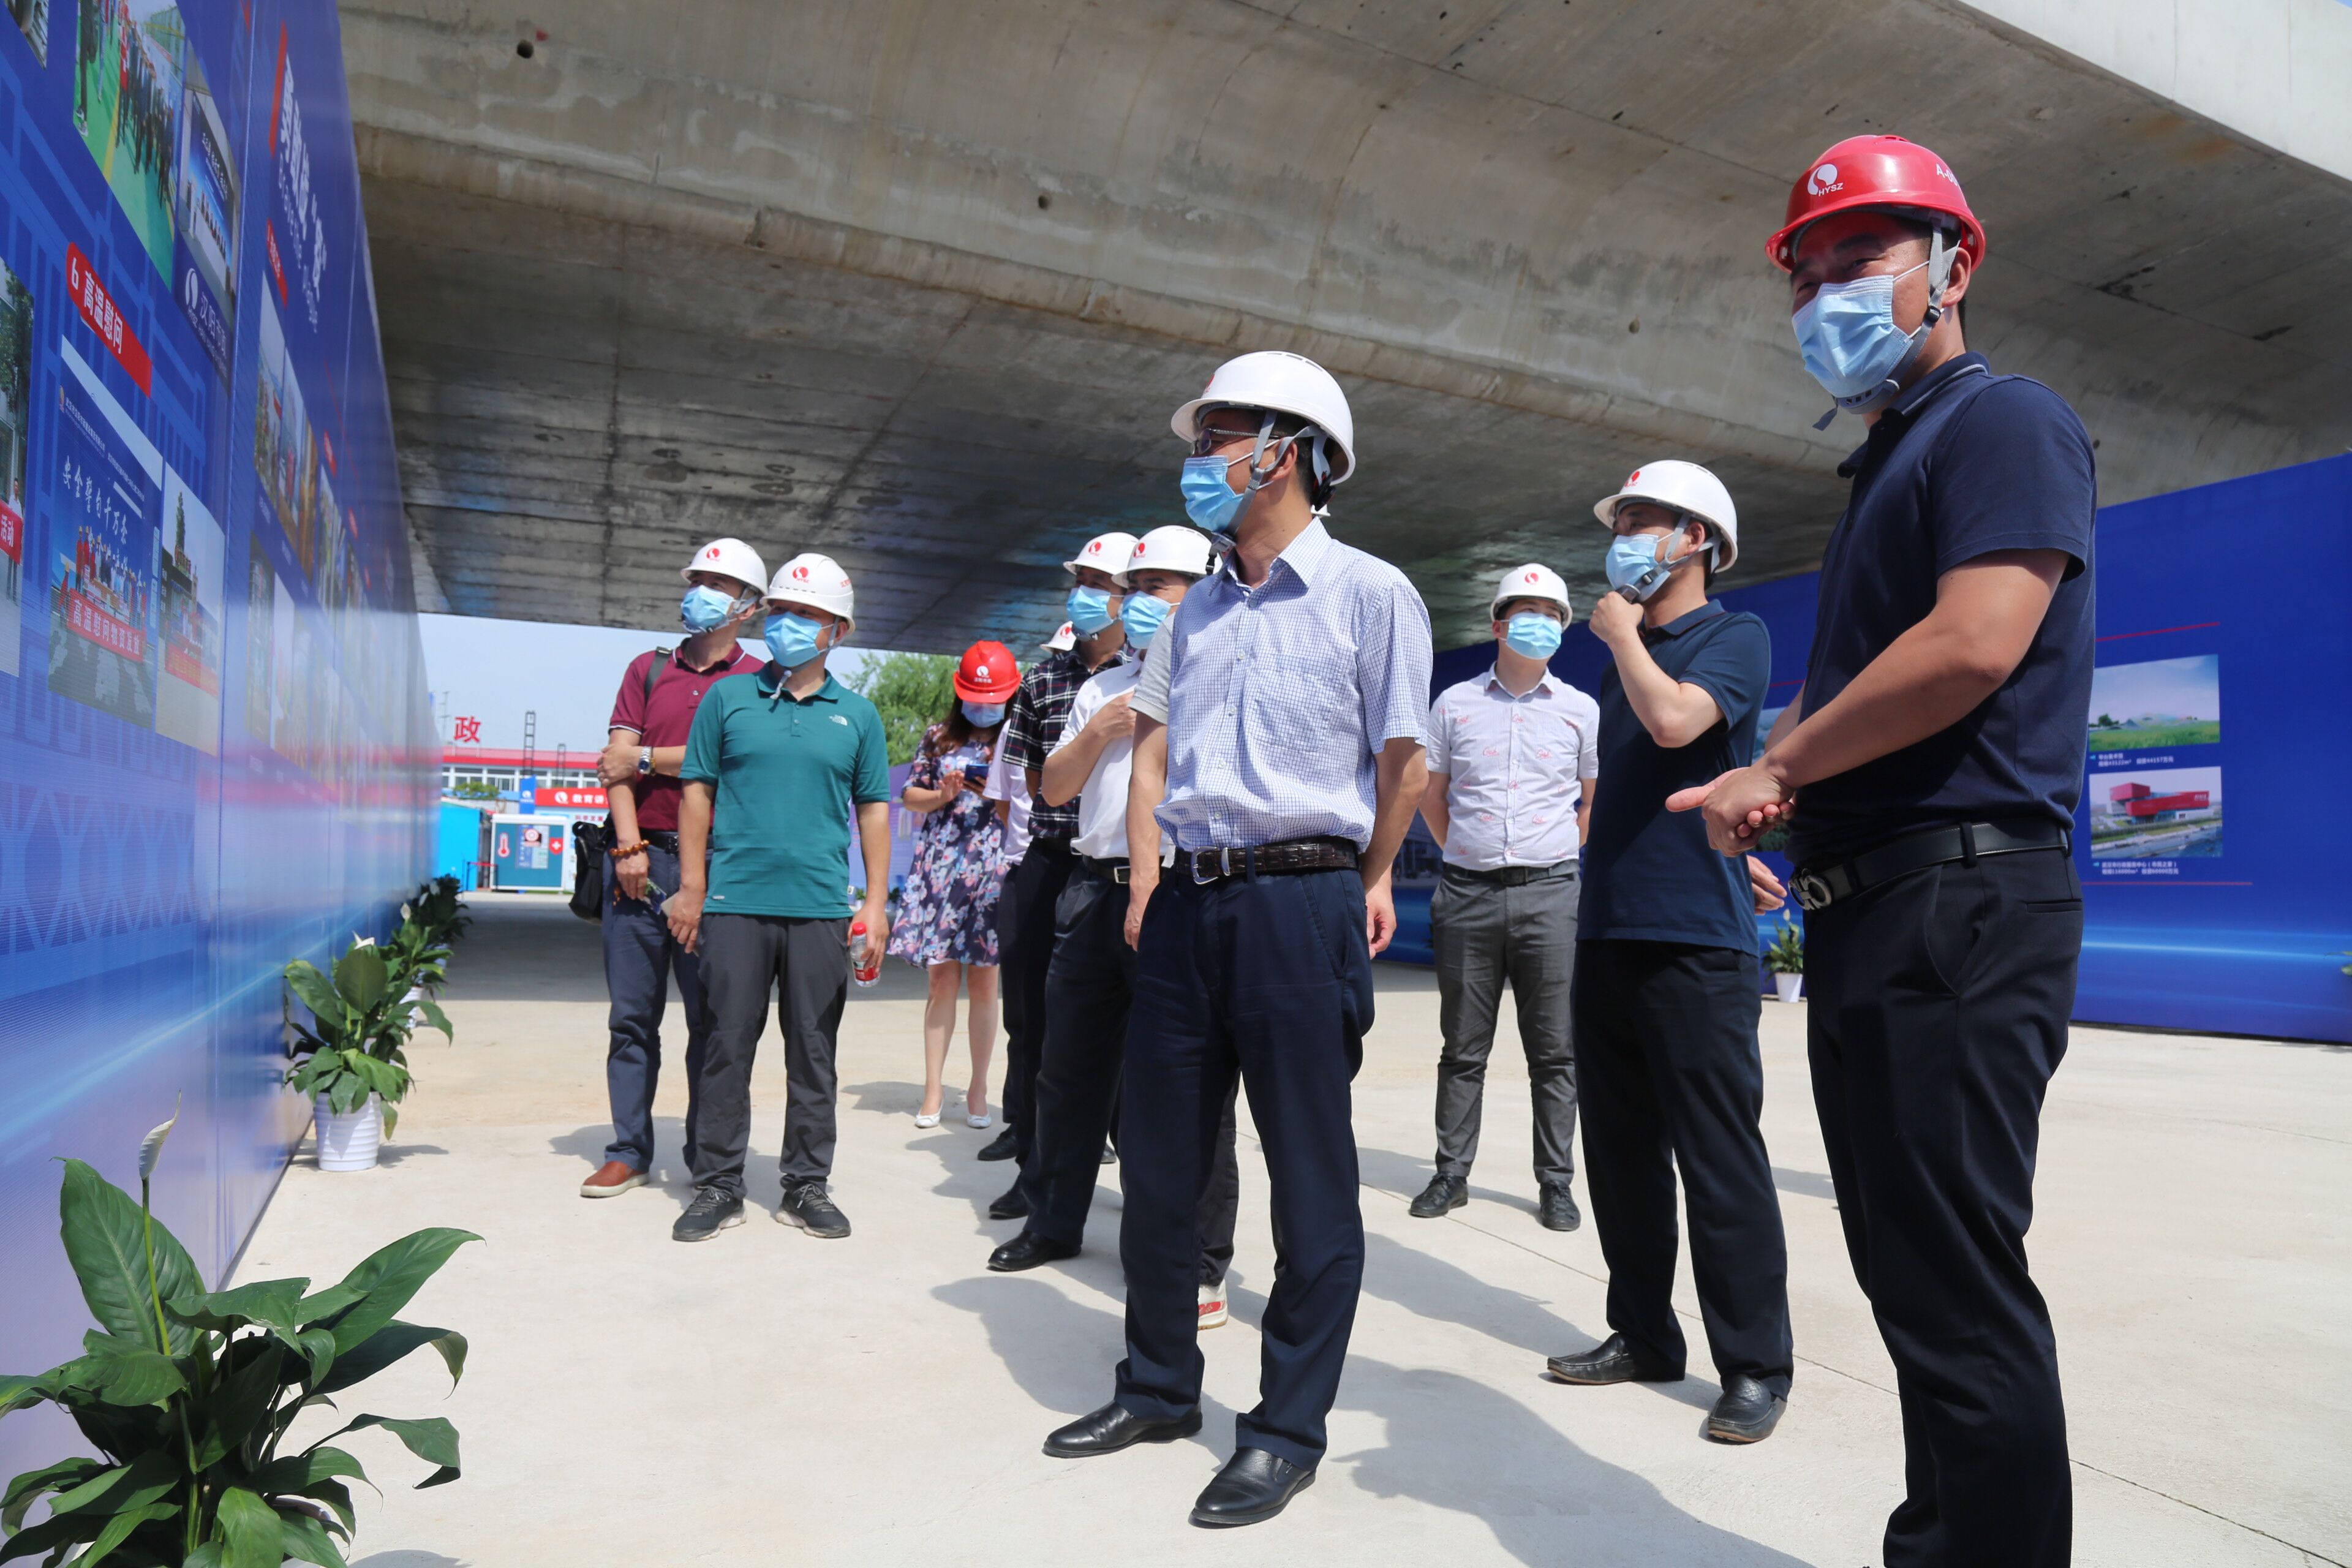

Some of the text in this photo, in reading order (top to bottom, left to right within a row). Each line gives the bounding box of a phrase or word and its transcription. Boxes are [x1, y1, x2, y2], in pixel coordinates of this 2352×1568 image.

[1819, 182, 1844, 197] HYSZ
[1936, 164, 1960, 188] A-00
[71, 257, 123, 354] 6 高温慰问
[63, 455, 127, 545] 安全警句千万条
[74, 600, 139, 655] 高温慰问物资发放
[454, 715, 481, 743] 政
[572, 794, 608, 805] 教育讲
